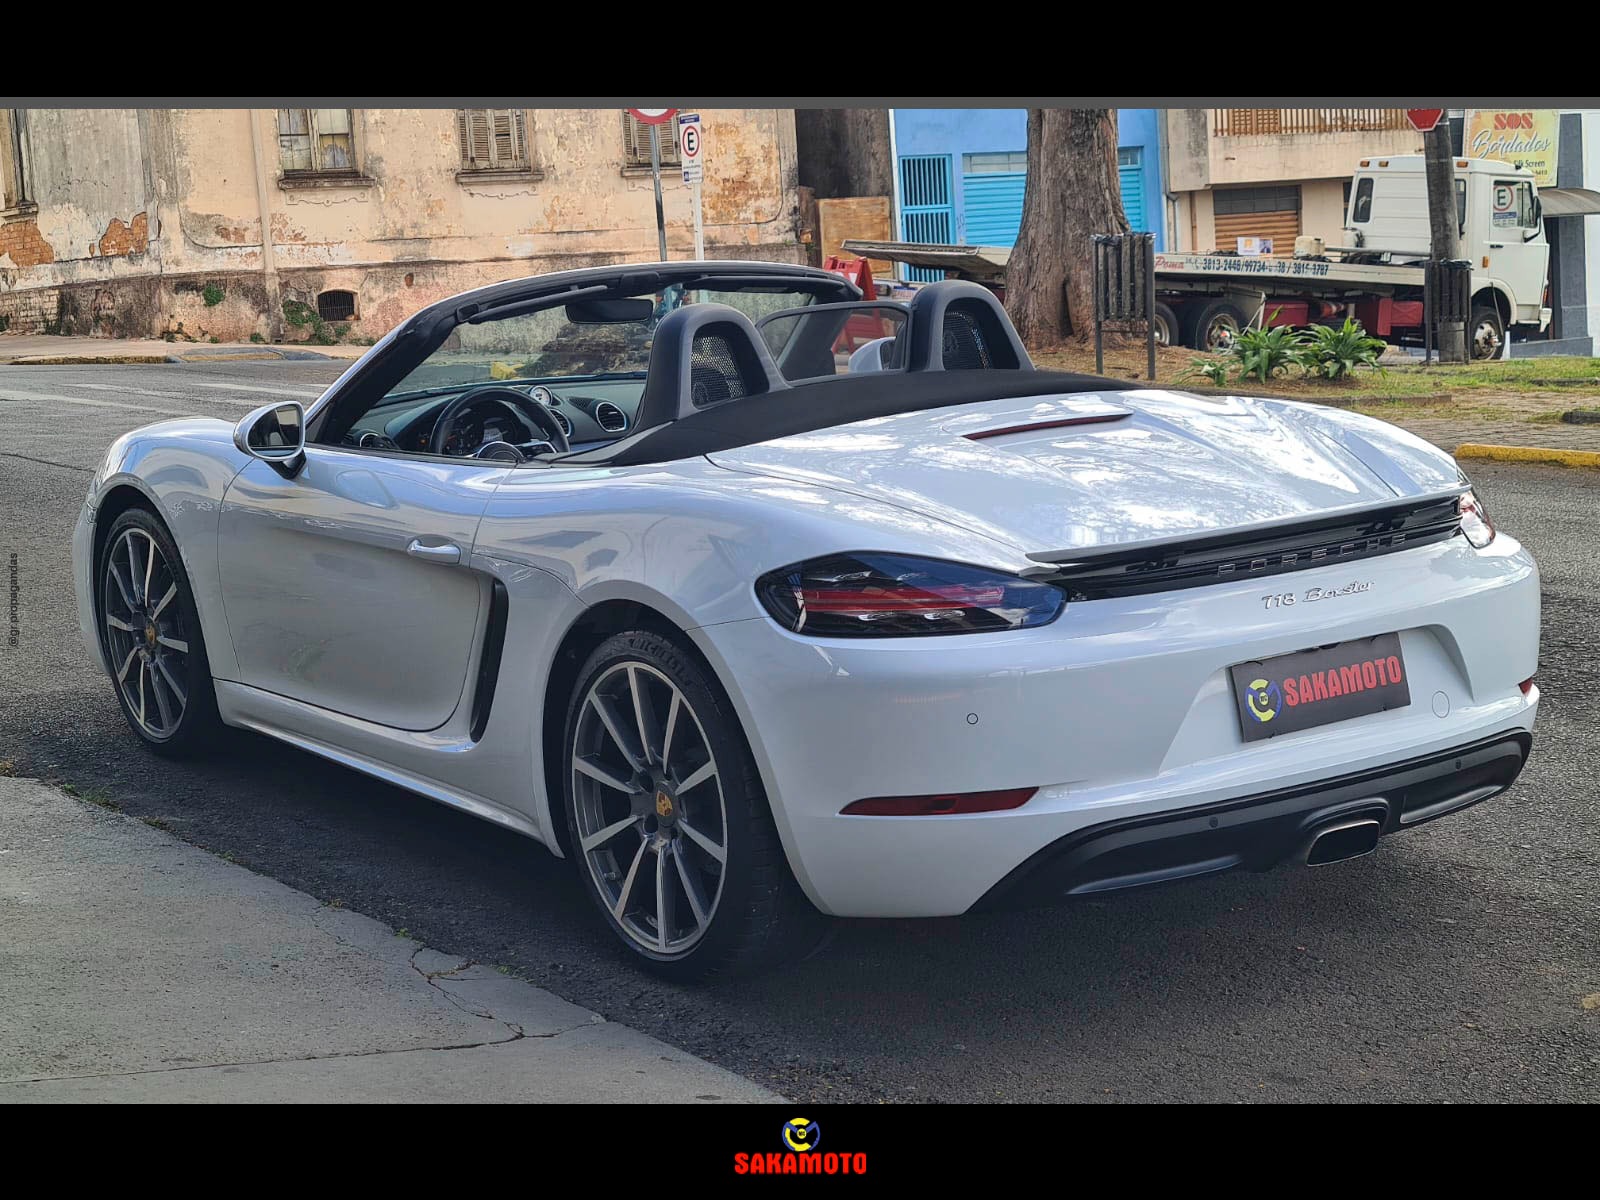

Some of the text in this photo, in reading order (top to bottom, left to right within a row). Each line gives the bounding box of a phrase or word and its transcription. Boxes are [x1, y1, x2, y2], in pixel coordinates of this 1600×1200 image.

[1494, 113, 1533, 130] SOS
[687, 131, 695, 152] E
[1472, 128, 1551, 159] Bordados
[1525, 159, 1545, 168] Screen
[1497, 189, 1506, 206] E
[1217, 533, 1406, 577] PORSCHE
[1262, 580, 1374, 609] 718 Boxster
[1283, 655, 1402, 706] SAKAMOTO
